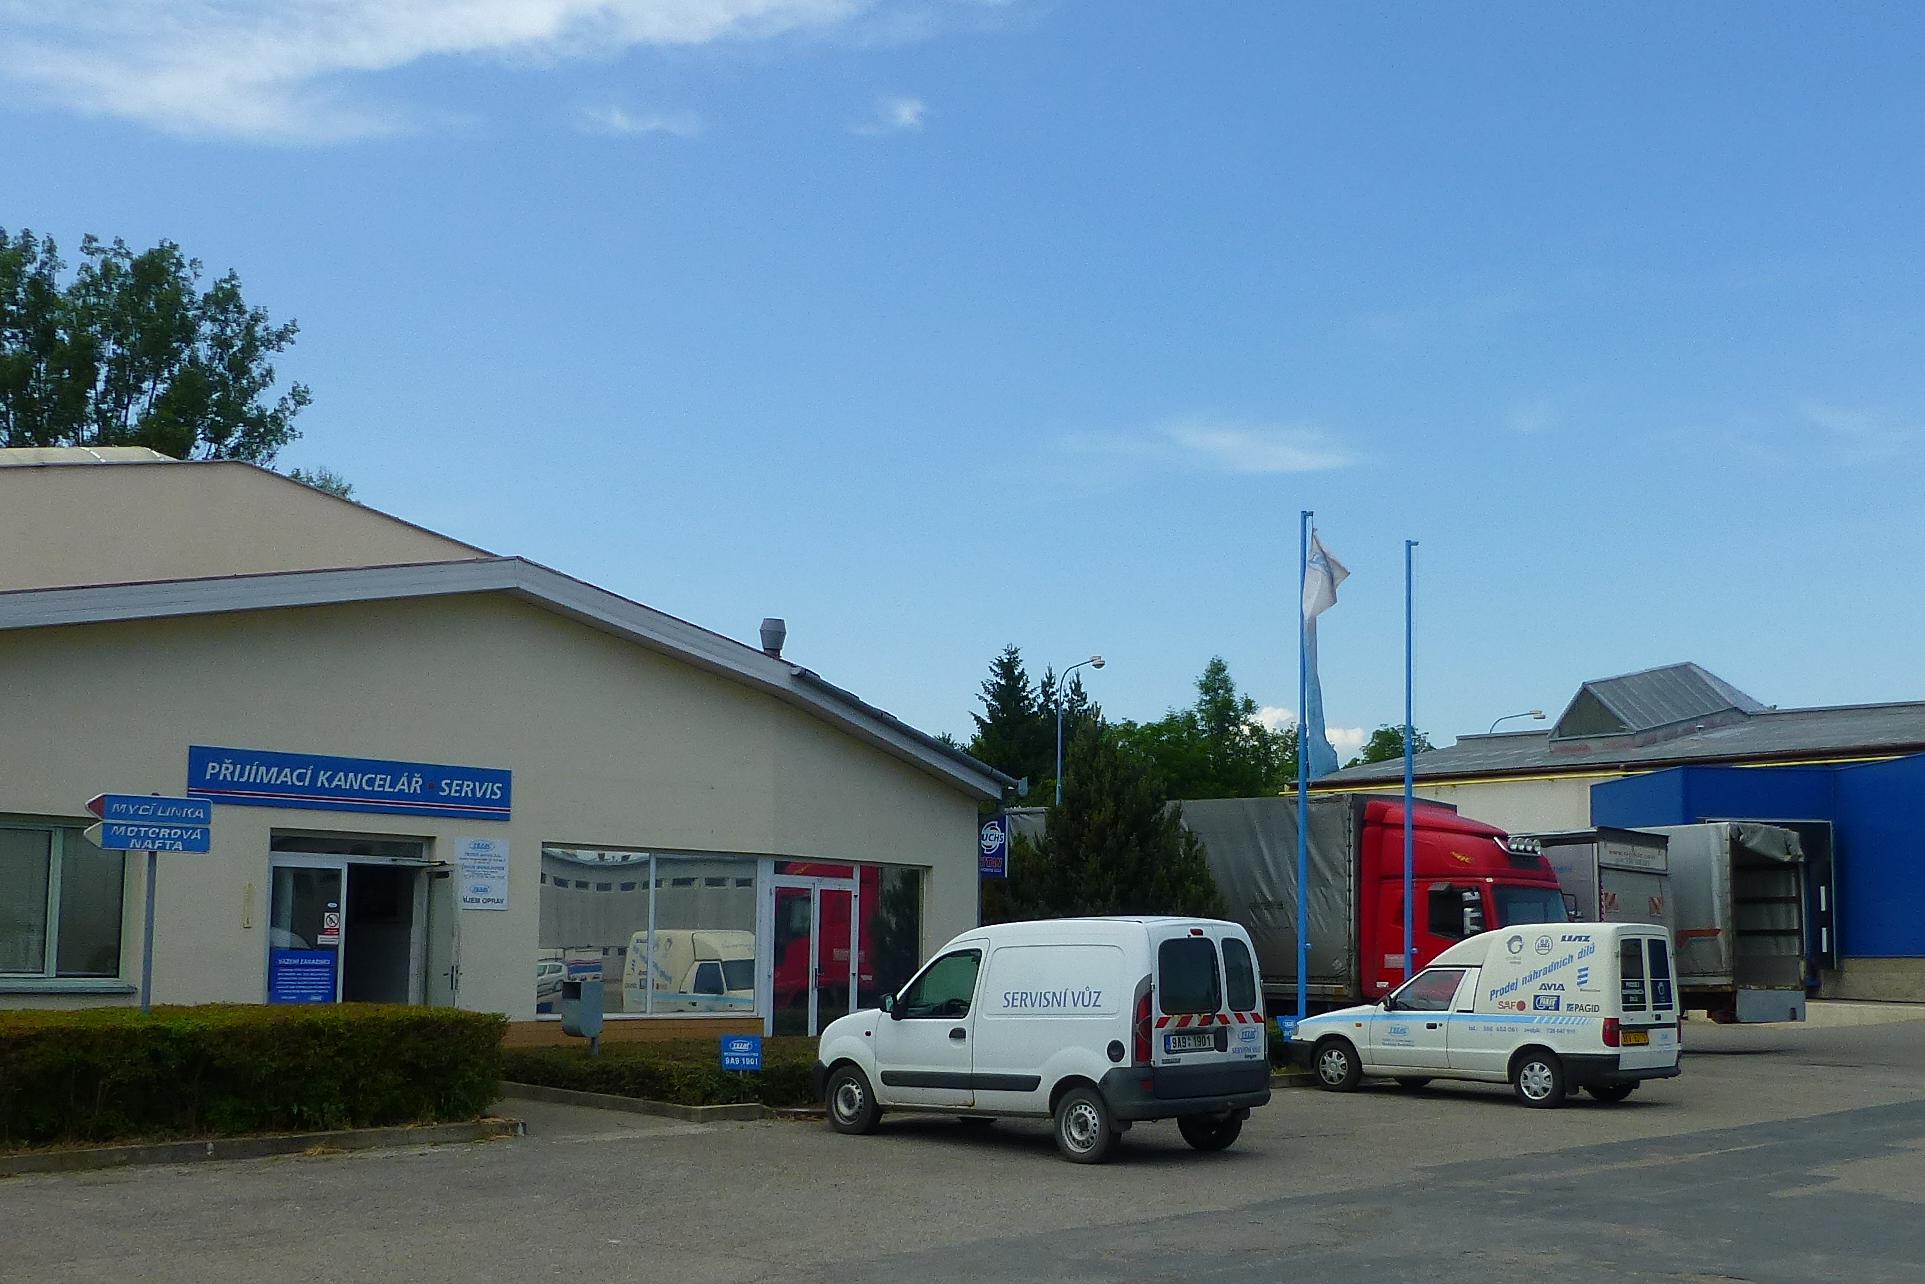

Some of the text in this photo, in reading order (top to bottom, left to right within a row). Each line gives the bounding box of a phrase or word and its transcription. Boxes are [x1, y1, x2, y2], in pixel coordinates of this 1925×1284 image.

[205, 759, 502, 800] PŘIJÍMACÍ KANCELÁŘ SERVIS
[157, 807, 204, 818] LINKA
[981, 832, 1004, 843] UCHS
[129, 839, 183, 850] NAFTA
[1489, 978, 1518, 1001] Prodej
[1538, 983, 1565, 991] AVIA
[1003, 985, 1102, 1008] SERVISNÍ VŮZ
[1574, 1003, 1600, 1013] PAGID
[1171, 1035, 1212, 1049] 9A9 1901
